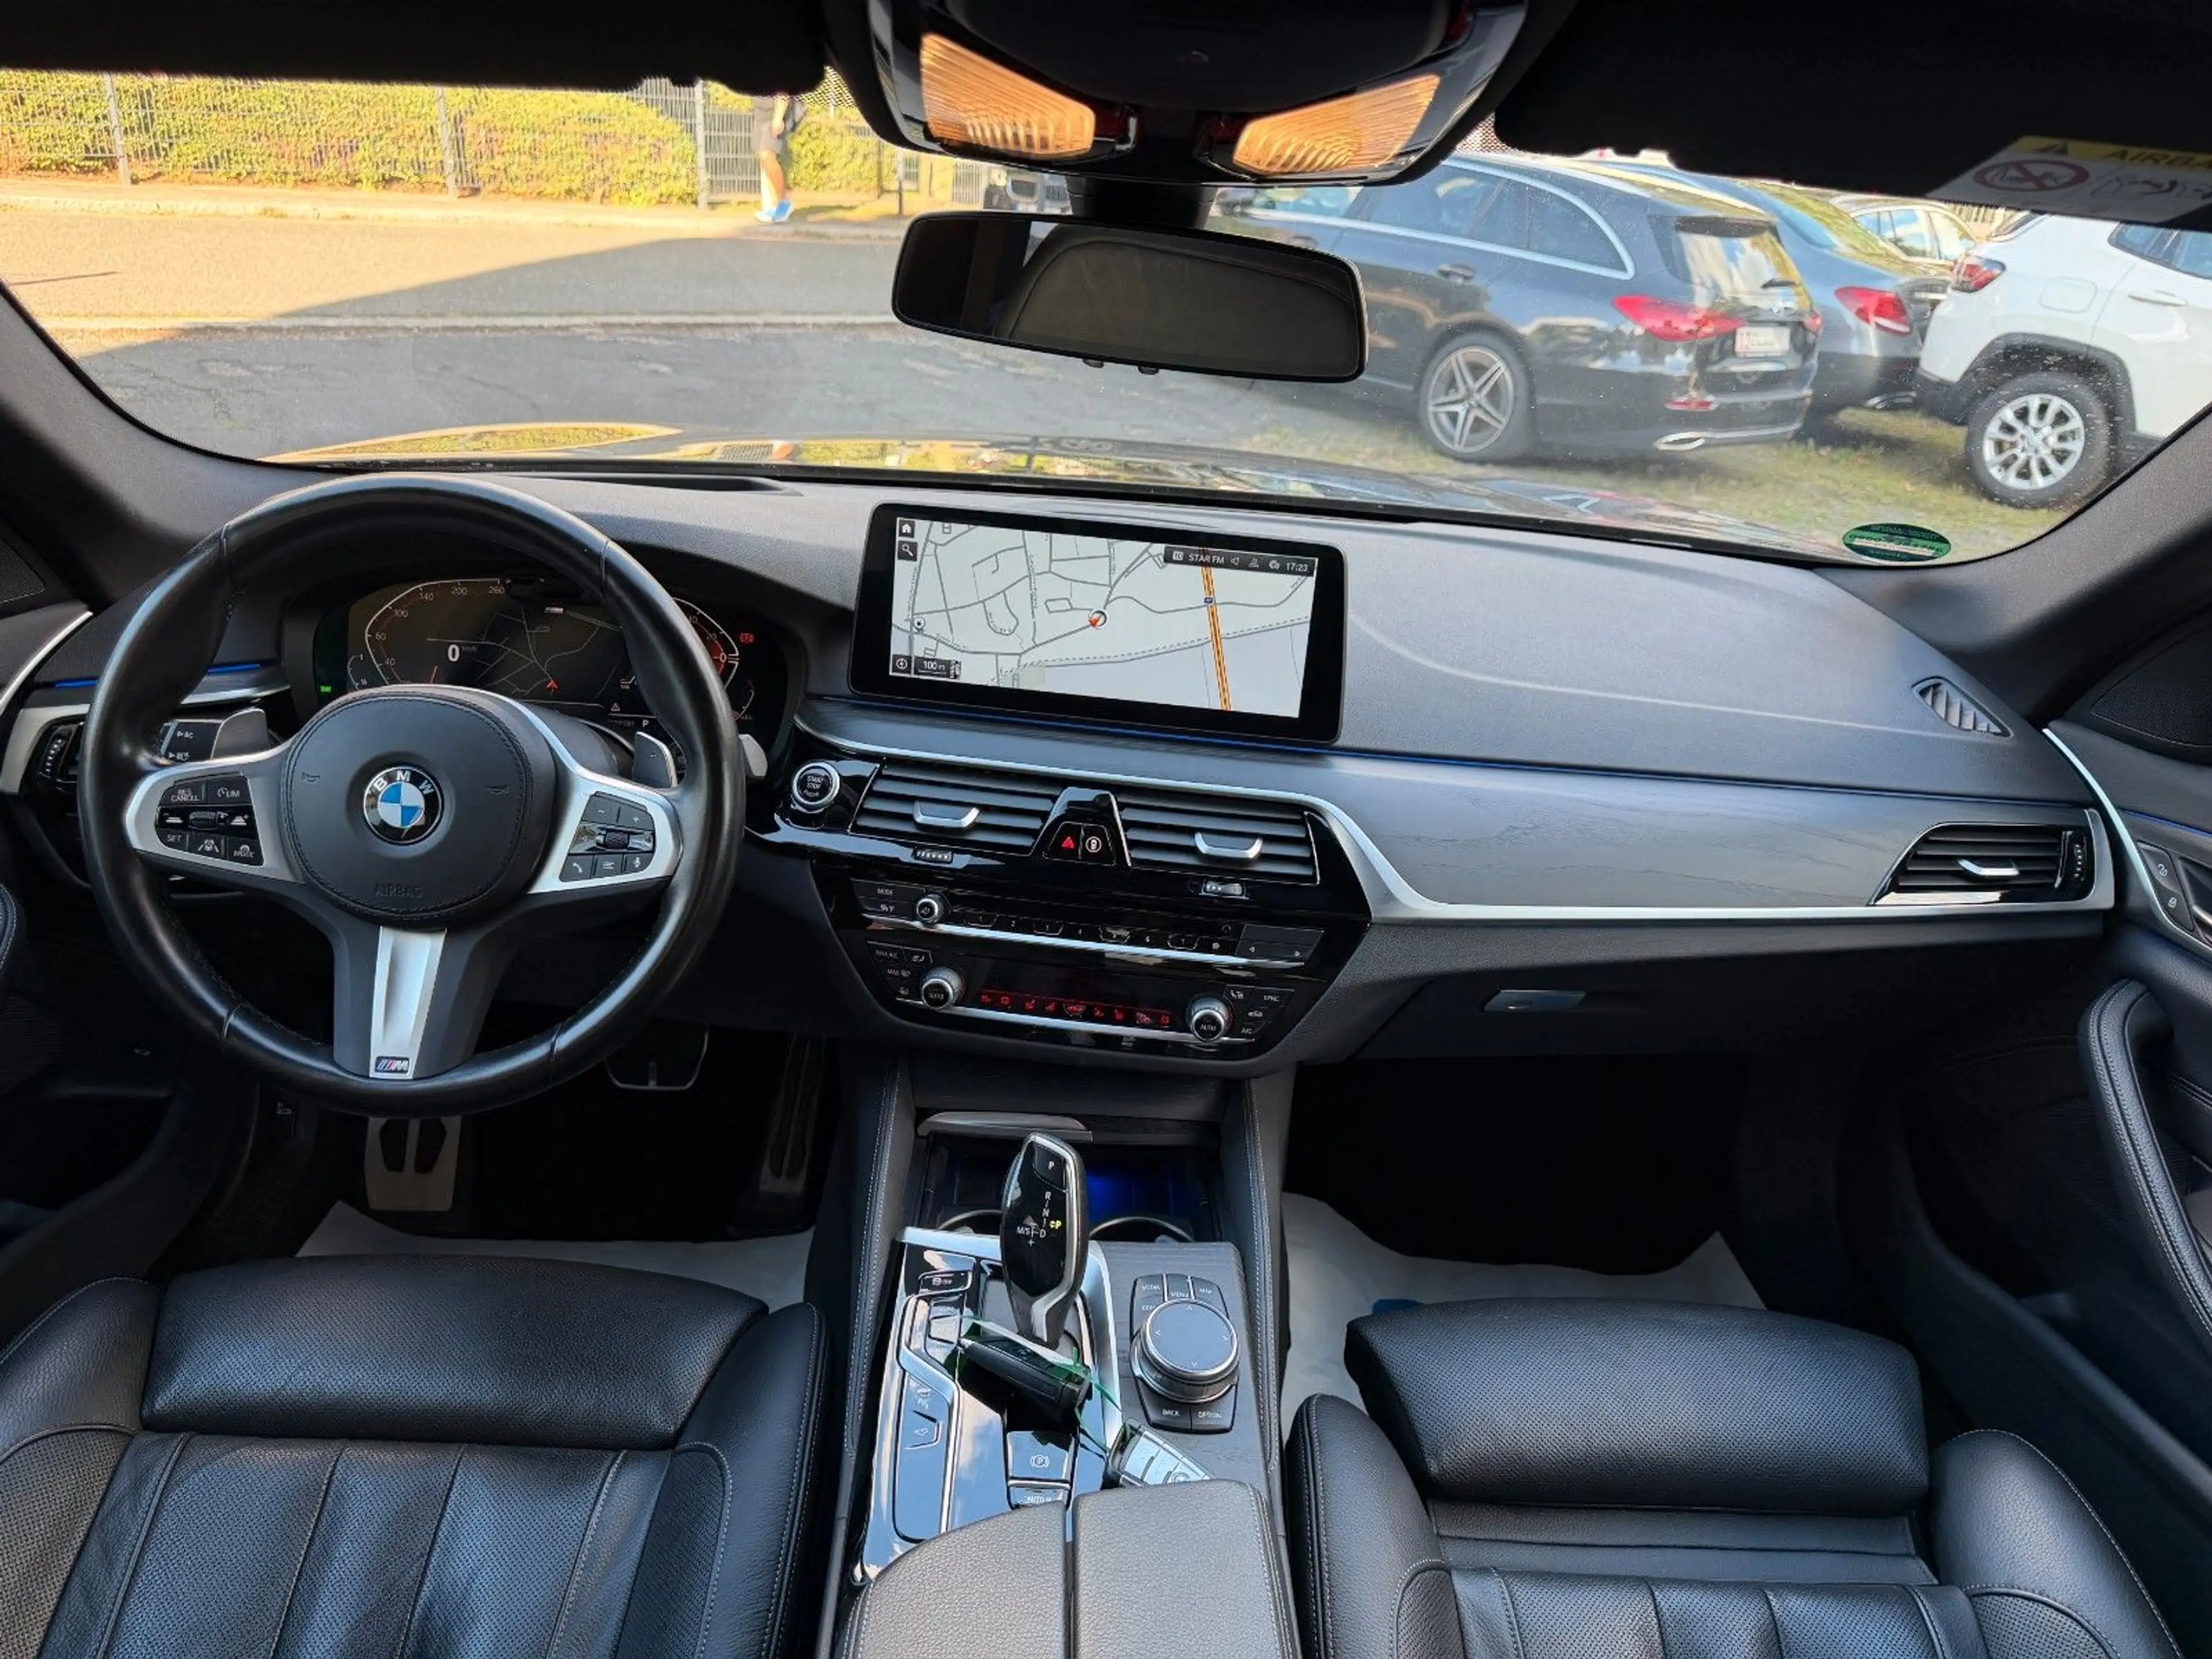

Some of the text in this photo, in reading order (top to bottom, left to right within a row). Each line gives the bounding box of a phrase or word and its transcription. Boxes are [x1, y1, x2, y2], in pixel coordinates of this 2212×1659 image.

[1188, 553, 1210, 563] STAR
[1212, 556, 1225, 565] FM
[1286, 562, 1308, 572] 17:23
[452, 586, 467, 595] 200
[488, 586, 505, 594] 260
[419, 592, 434, 601] 140
[394, 608, 408, 618] 100
[448, 644, 460, 662] 0
[385, 657, 396, 665] 40
[923, 661, 937, 670] 100
[373, 770, 434, 795] BMW
[171, 794, 200, 802] CANCEL
[226, 790, 240, 798] LIM
[167, 834, 181, 842] SET
[1048, 1161, 1055, 1170] P
[1044, 1191, 1052, 1200] R
[1041, 1207, 1050, 1217] N
[1039, 1229, 1046, 1238] D
[1198, 1411, 1222, 1419] OPTION
[1027, 1495, 1044, 1503] AUTO
